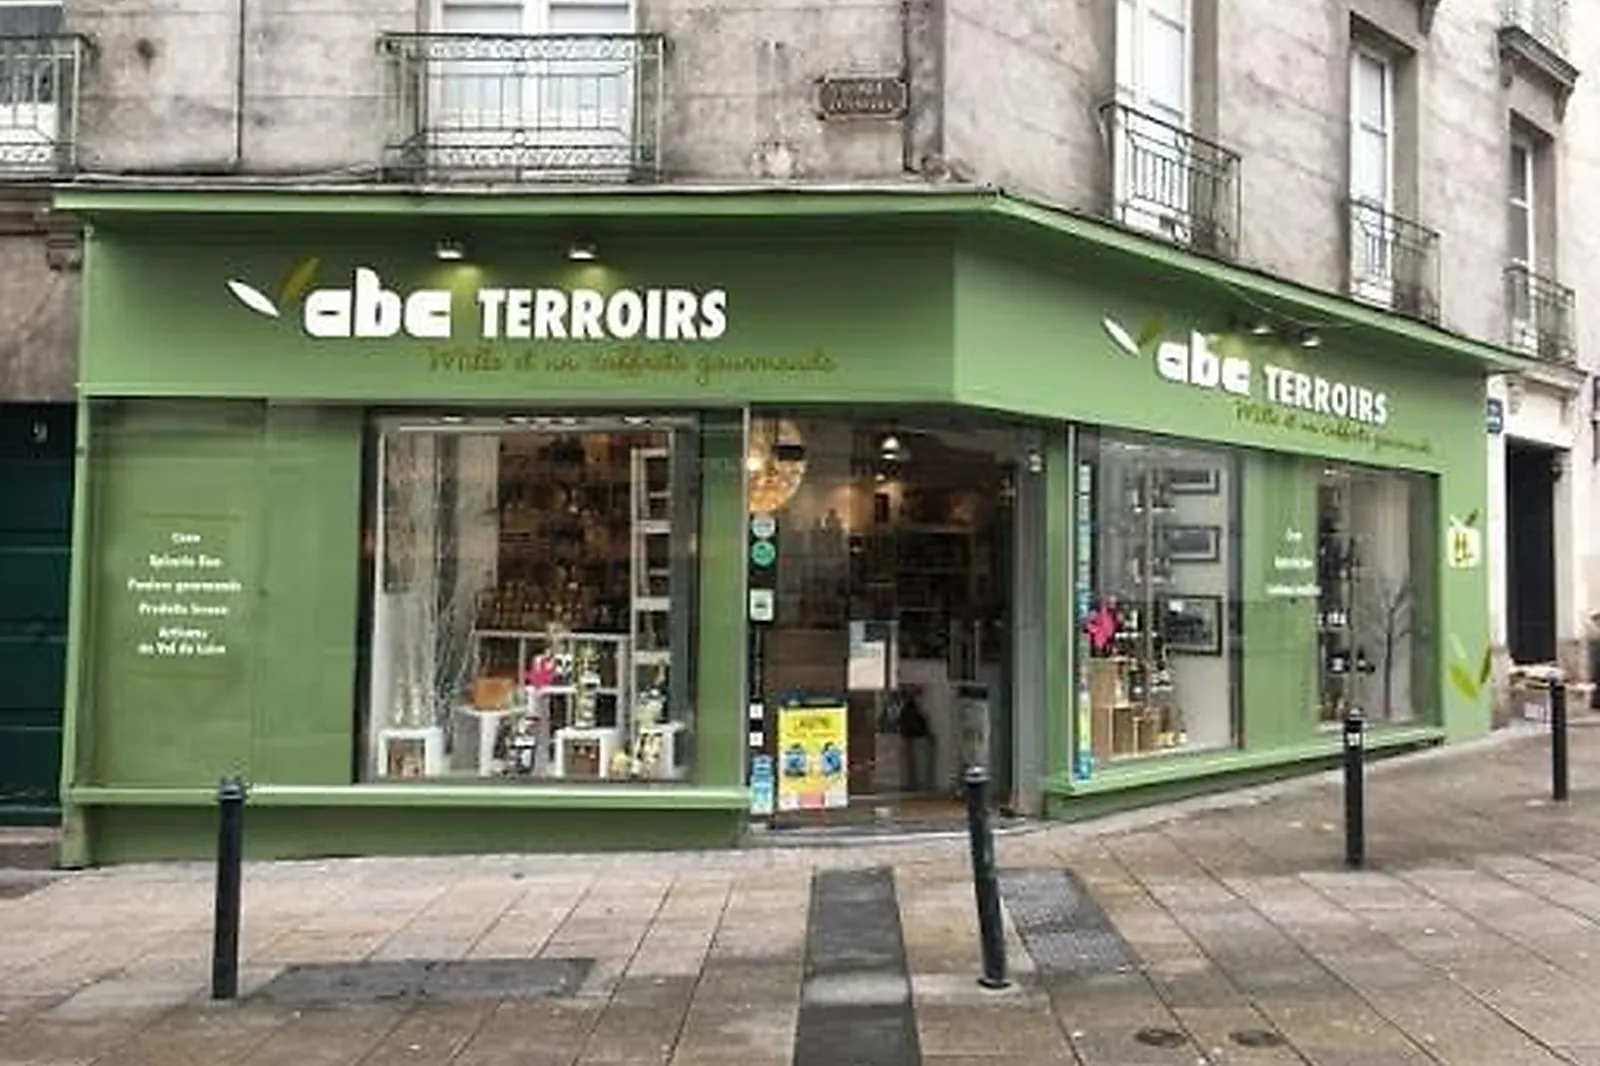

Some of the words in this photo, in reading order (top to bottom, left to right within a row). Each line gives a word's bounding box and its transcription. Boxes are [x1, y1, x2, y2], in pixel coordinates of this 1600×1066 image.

[305, 267, 451, 339] abc
[478, 288, 728, 341] TERROIRS
[1156, 328, 1251, 397] abc
[1263, 362, 1390, 427] TERROIRS
